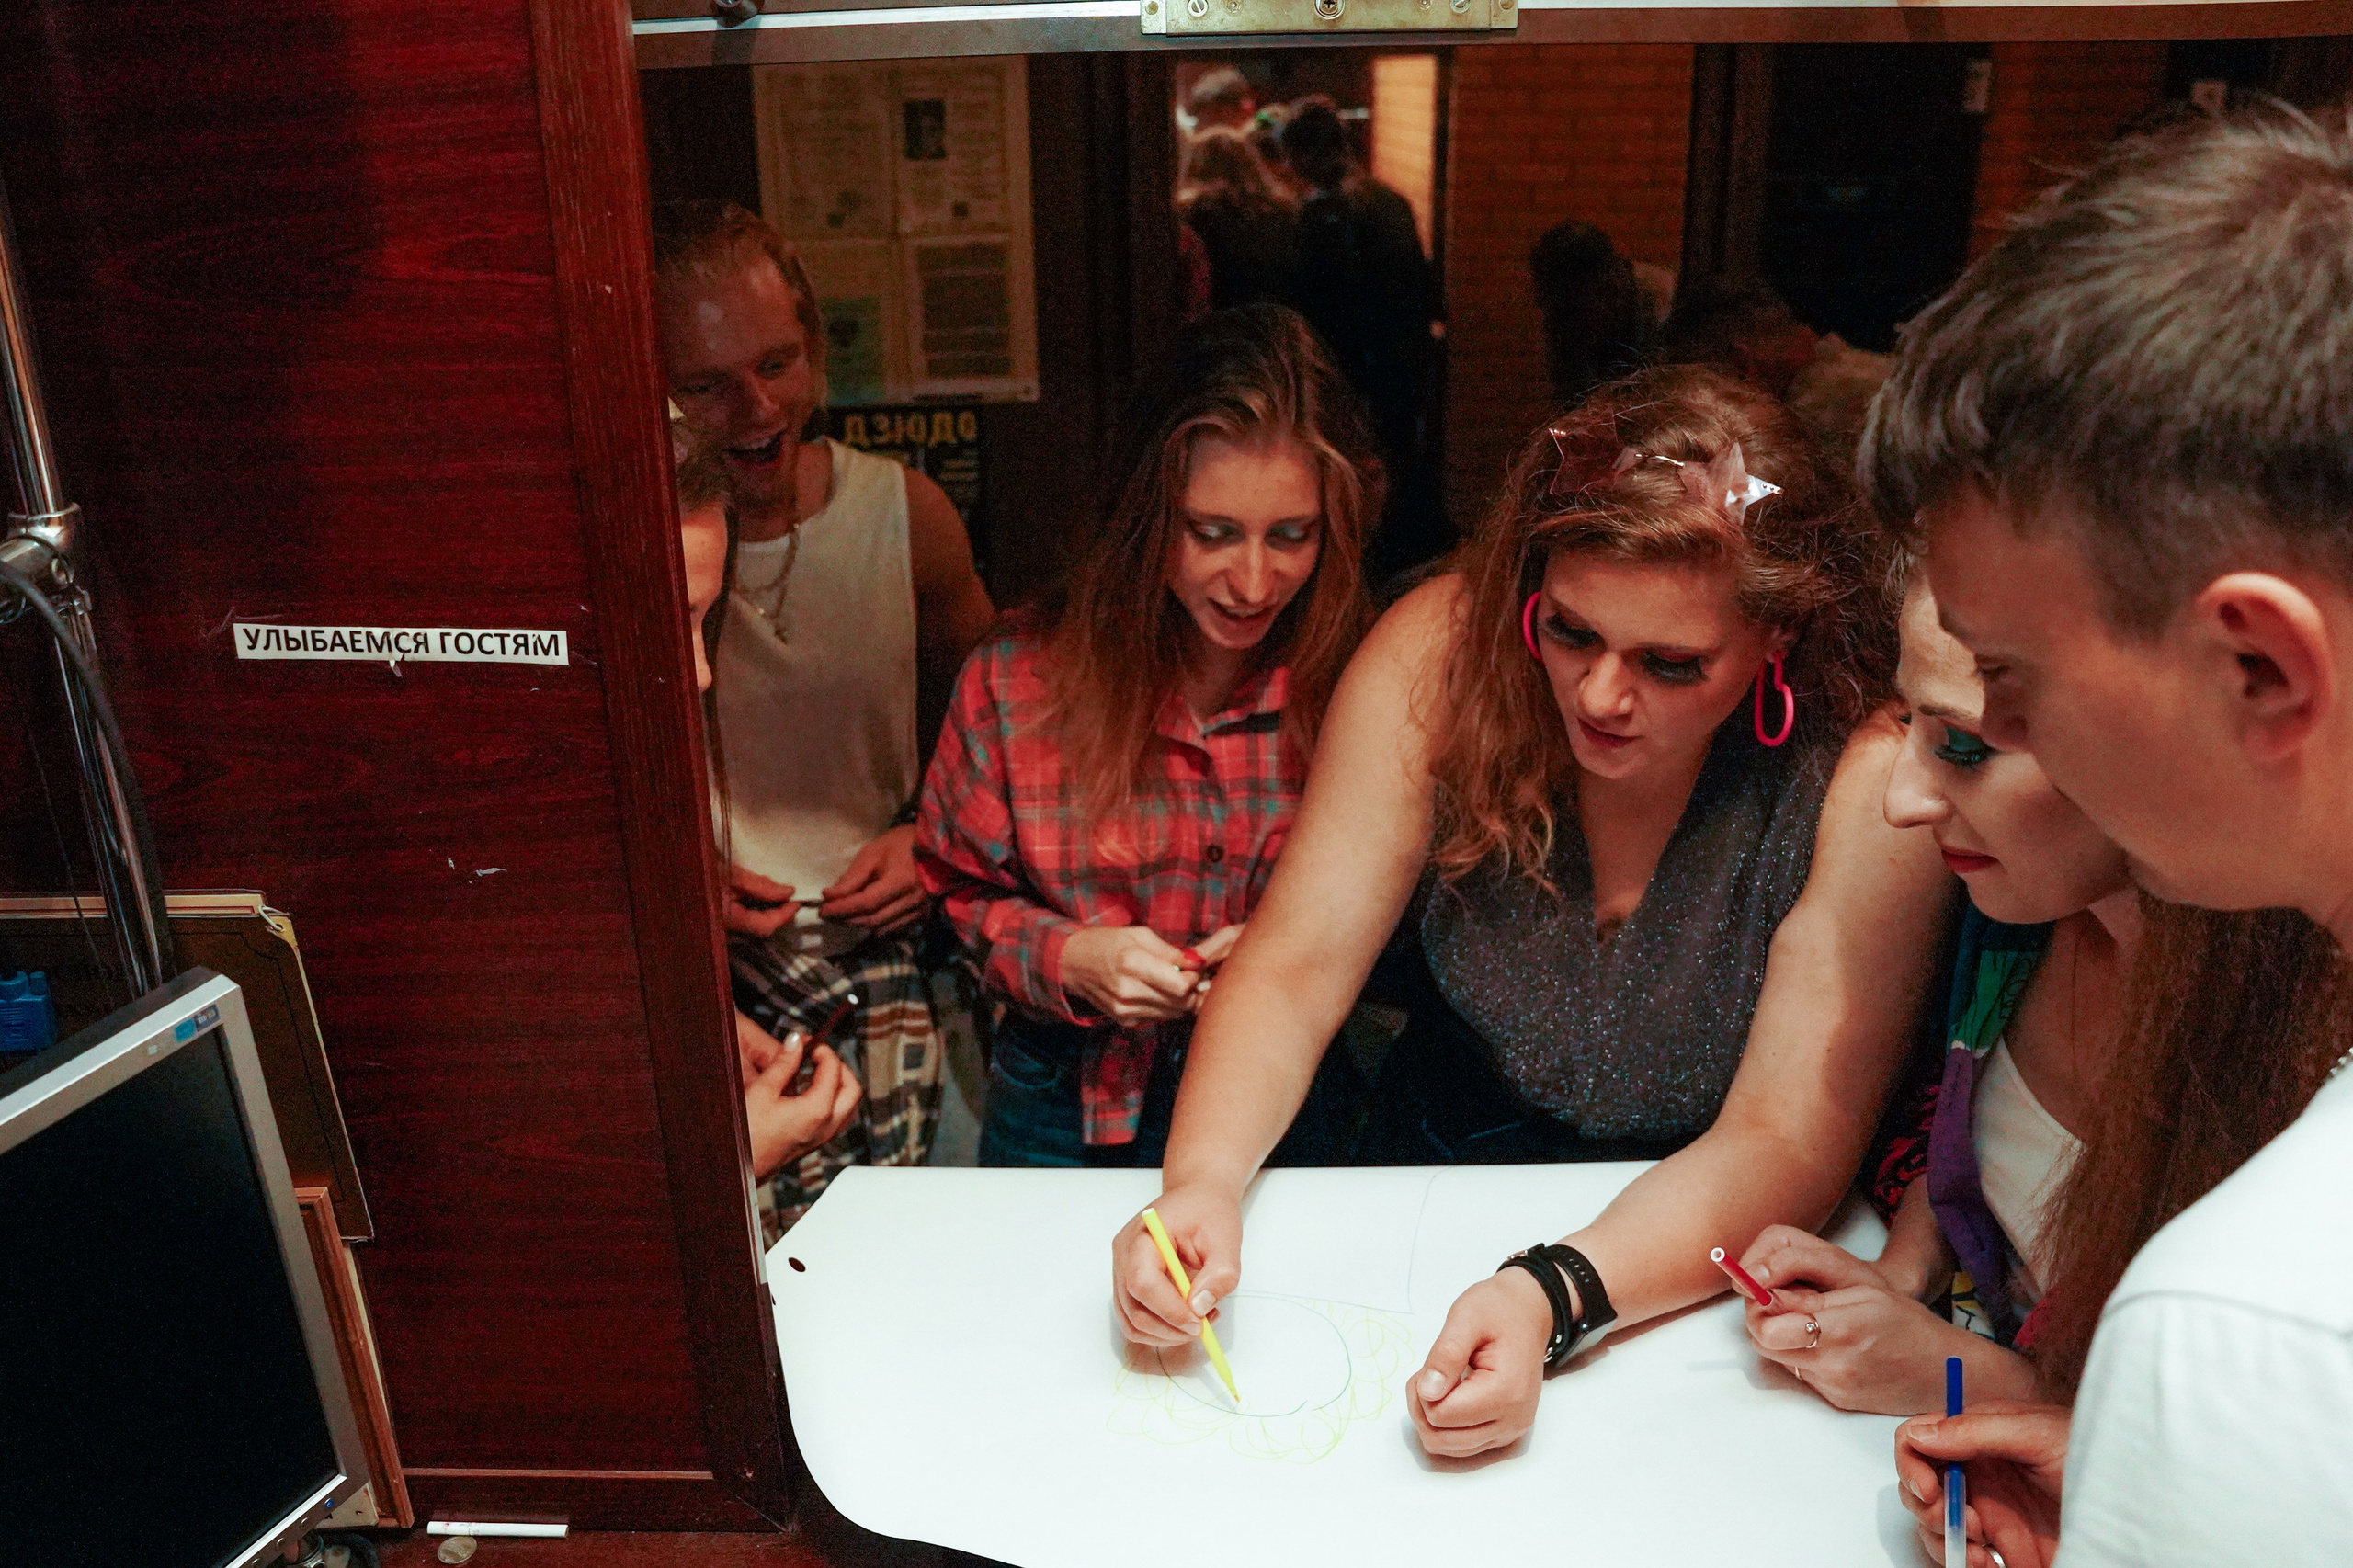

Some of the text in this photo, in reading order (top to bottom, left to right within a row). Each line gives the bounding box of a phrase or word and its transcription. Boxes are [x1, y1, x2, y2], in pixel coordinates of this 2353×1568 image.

[843, 410, 978, 447] ДЗЮДО
[243, 628, 560, 656] УЛЫБАЕМСЯ ГОСТЯМ
